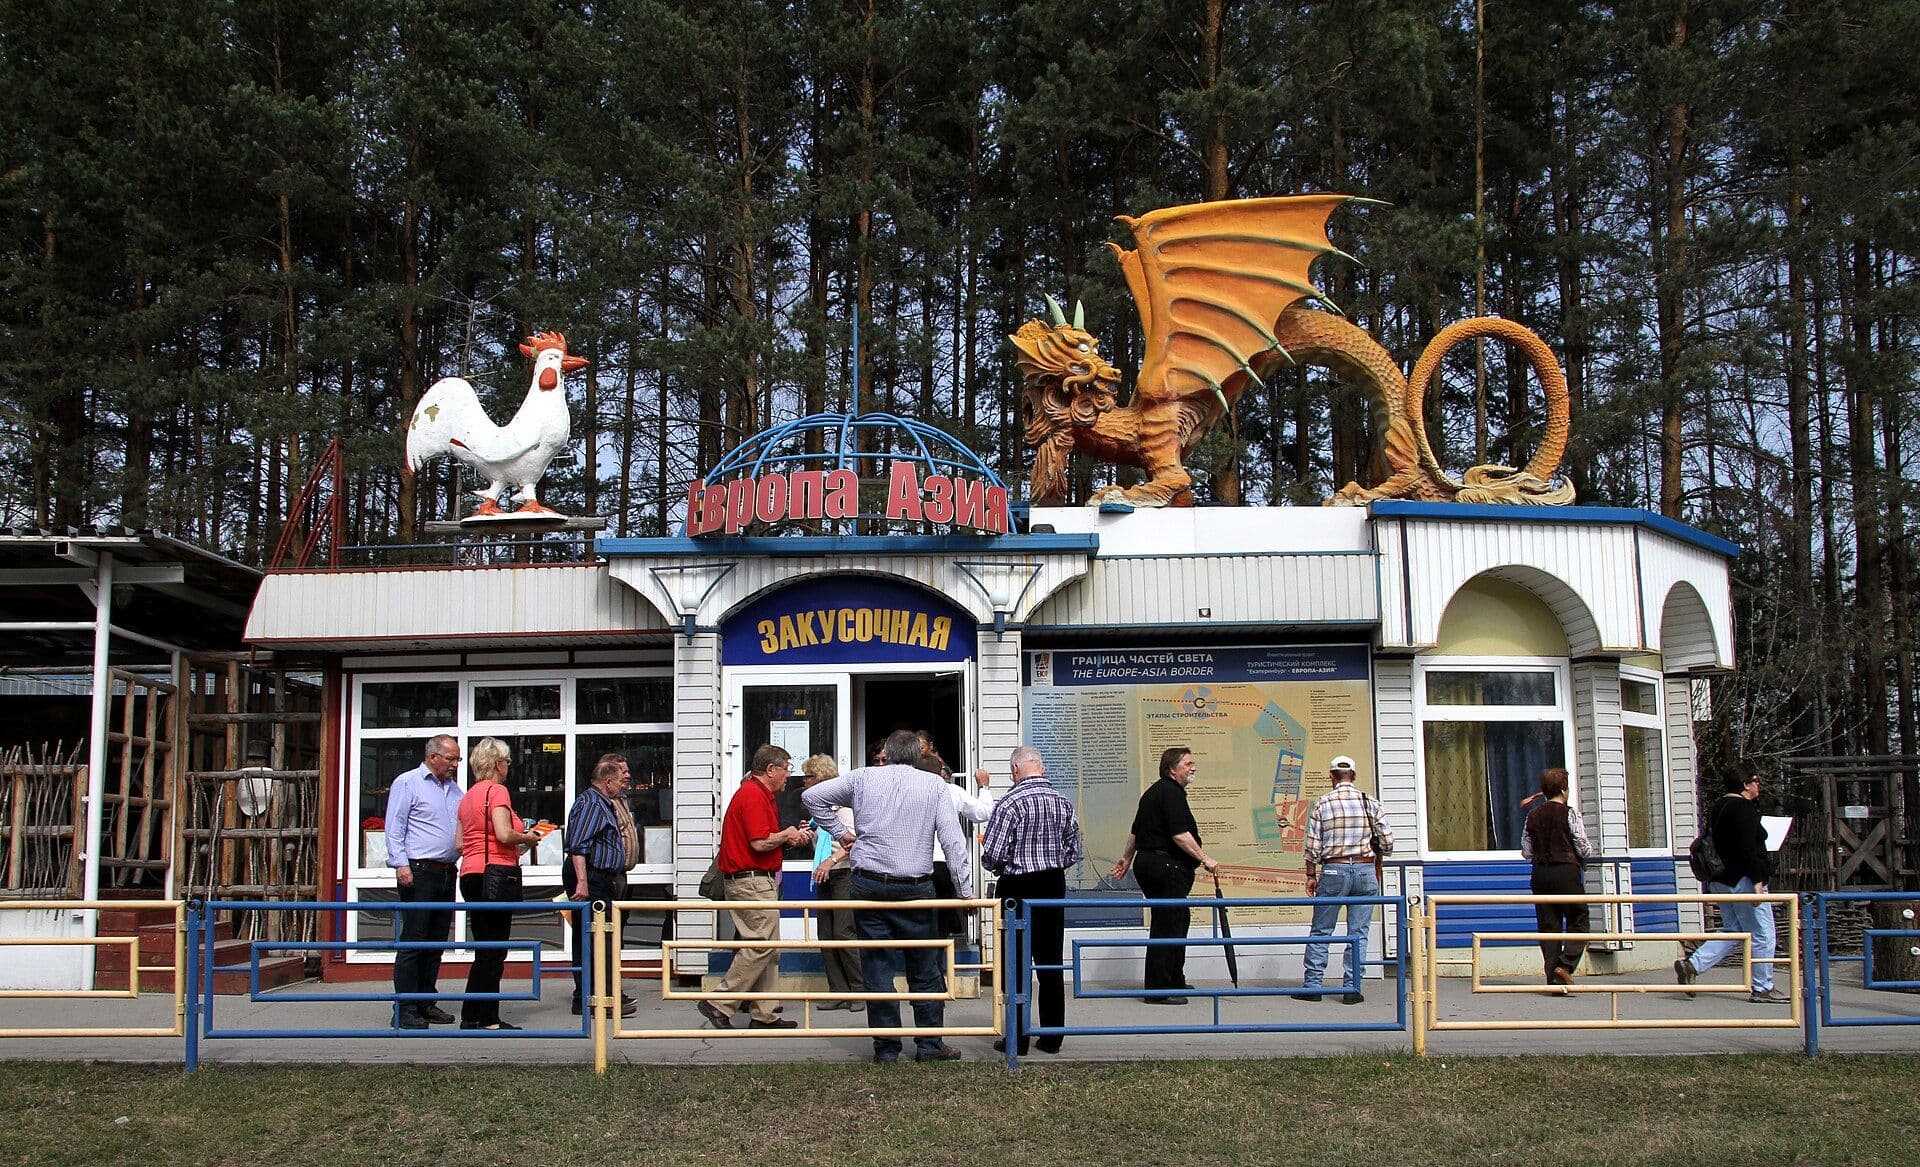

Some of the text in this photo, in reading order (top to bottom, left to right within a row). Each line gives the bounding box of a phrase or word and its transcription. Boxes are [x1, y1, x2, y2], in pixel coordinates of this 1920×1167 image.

[685, 460, 1009, 538] Европа Азия
[757, 607, 953, 655] ЗАКУСОЧНАЯ
[1129, 653, 1175, 664] ЧАСТЕЙ
[1177, 653, 1214, 663] СВЕТА
[1247, 660, 1300, 668] ТУРИСТИЧЕСКИЙ
[1072, 667, 1214, 679] THE EUROPE-ASIA BORDER
